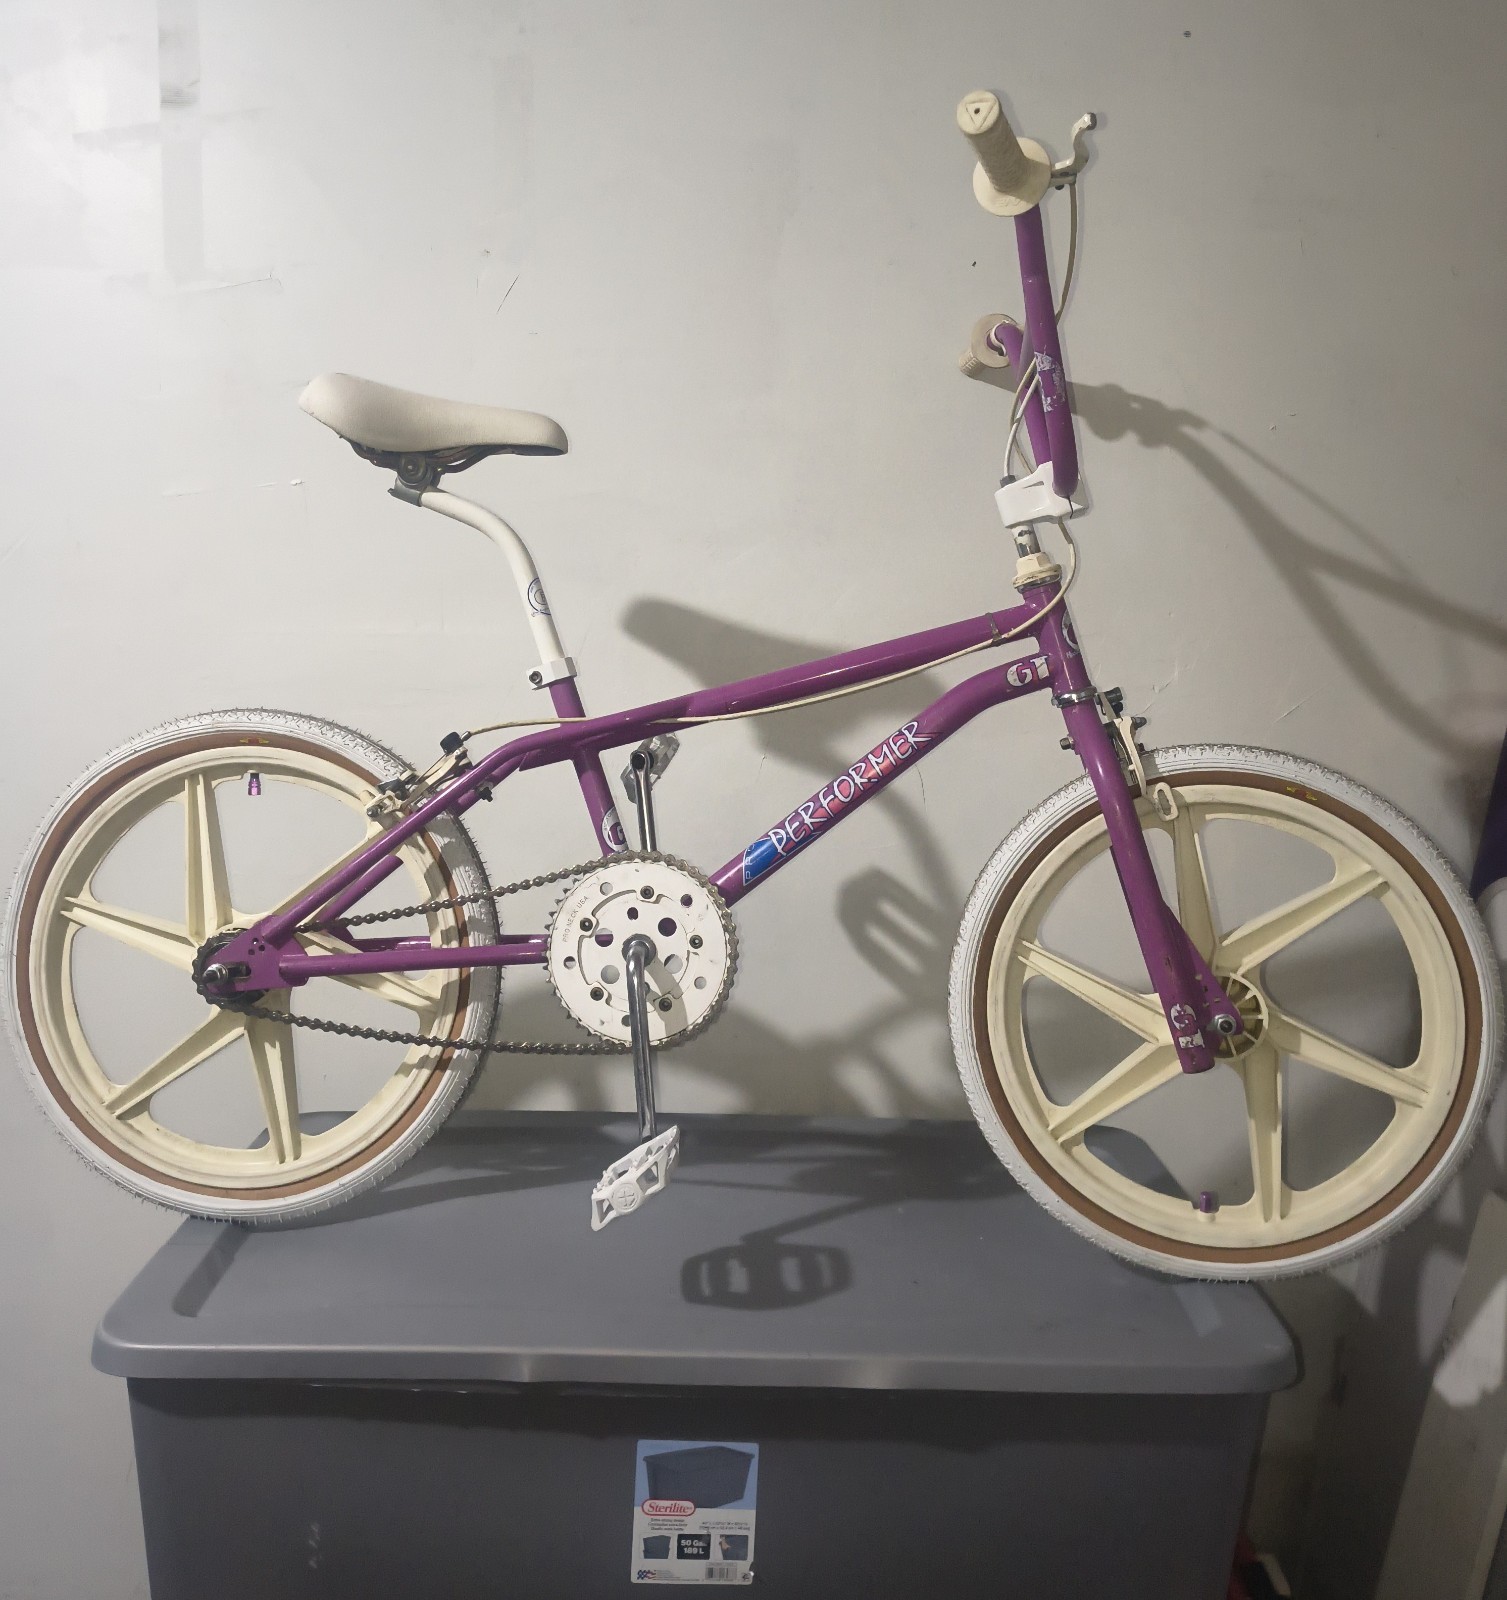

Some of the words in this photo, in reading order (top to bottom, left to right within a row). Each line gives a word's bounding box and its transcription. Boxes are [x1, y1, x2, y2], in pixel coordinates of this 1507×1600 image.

[1007, 656, 1049, 686] GT
[768, 721, 932, 856] PERFORMER
[647, 1502, 689, 1514] Sterilite
